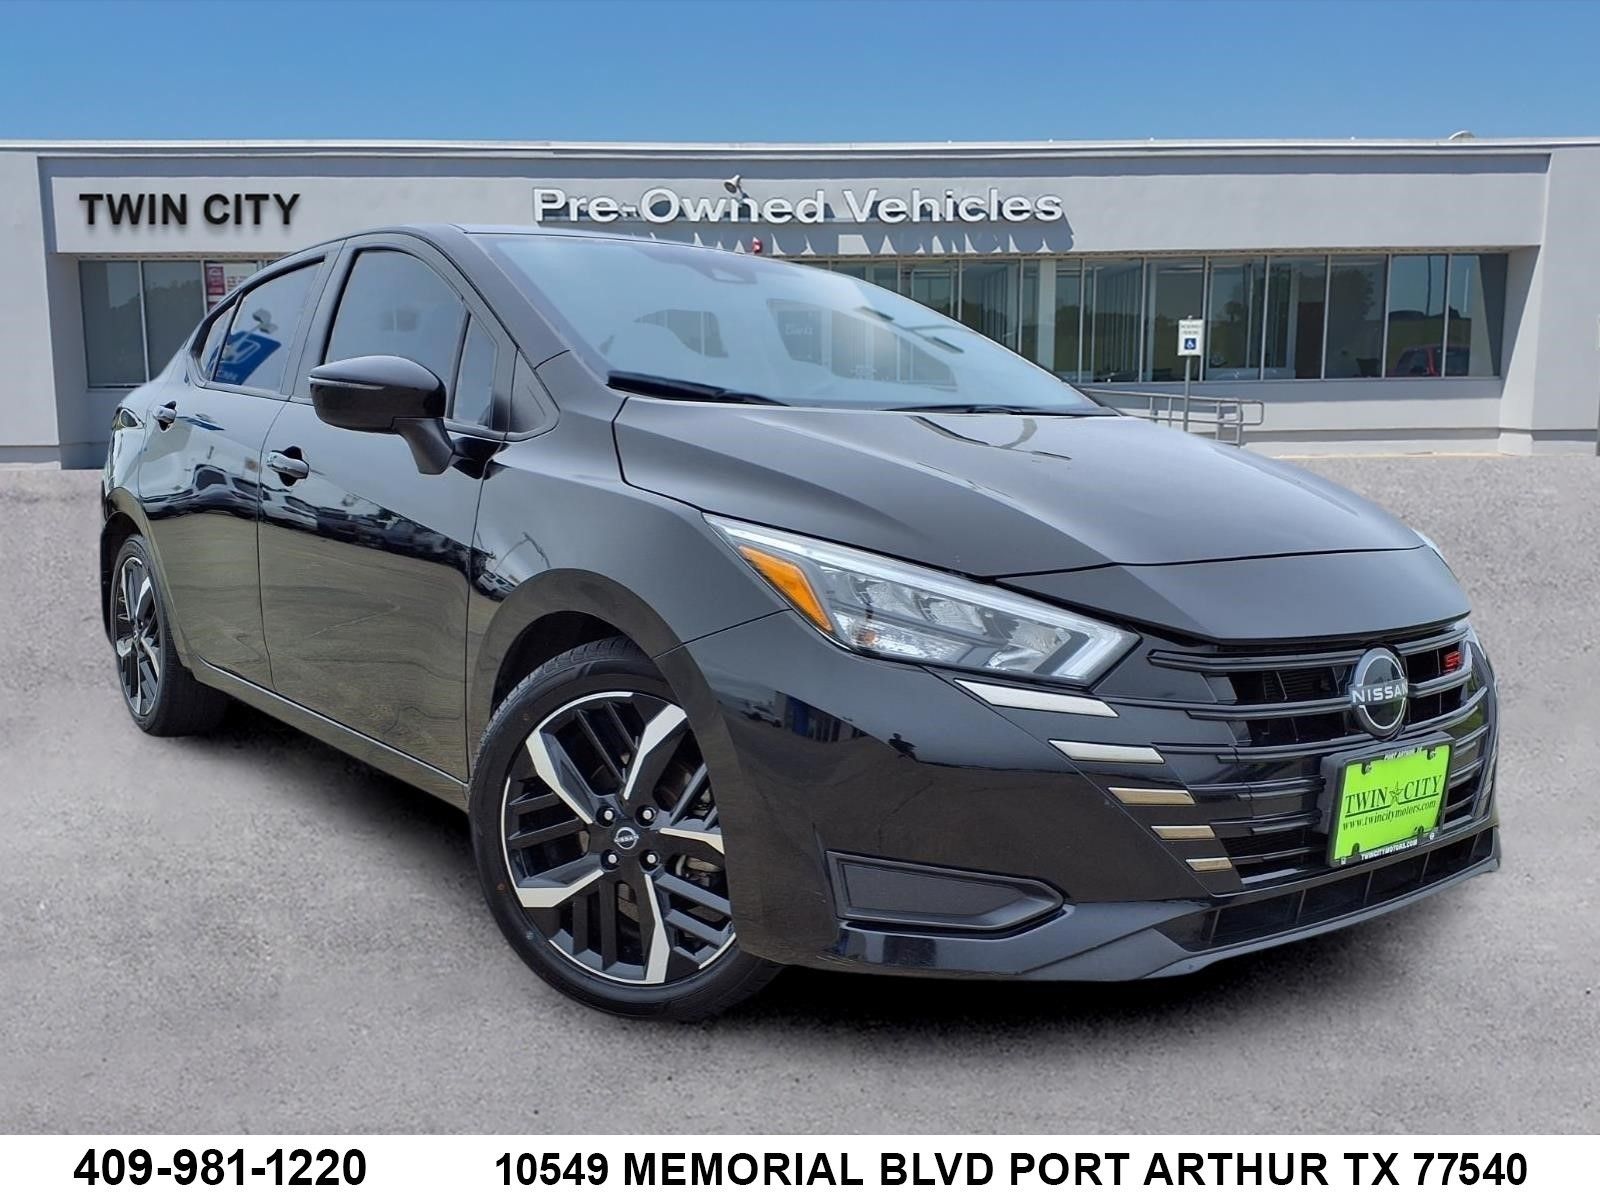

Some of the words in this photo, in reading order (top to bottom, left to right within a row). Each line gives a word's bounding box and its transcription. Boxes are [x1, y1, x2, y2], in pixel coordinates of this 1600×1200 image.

[78, 193, 187, 226] TWIN
[203, 193, 300, 226] CITY
[533, 187, 825, 224] Pre-Owned
[843, 188, 1064, 224] Vehicles
[1352, 681, 1408, 703] NISSAN
[1345, 787, 1388, 814] TWIN
[1404, 775, 1442, 800] CITY
[1343, 799, 1437, 831] www.twincitymotors.com
